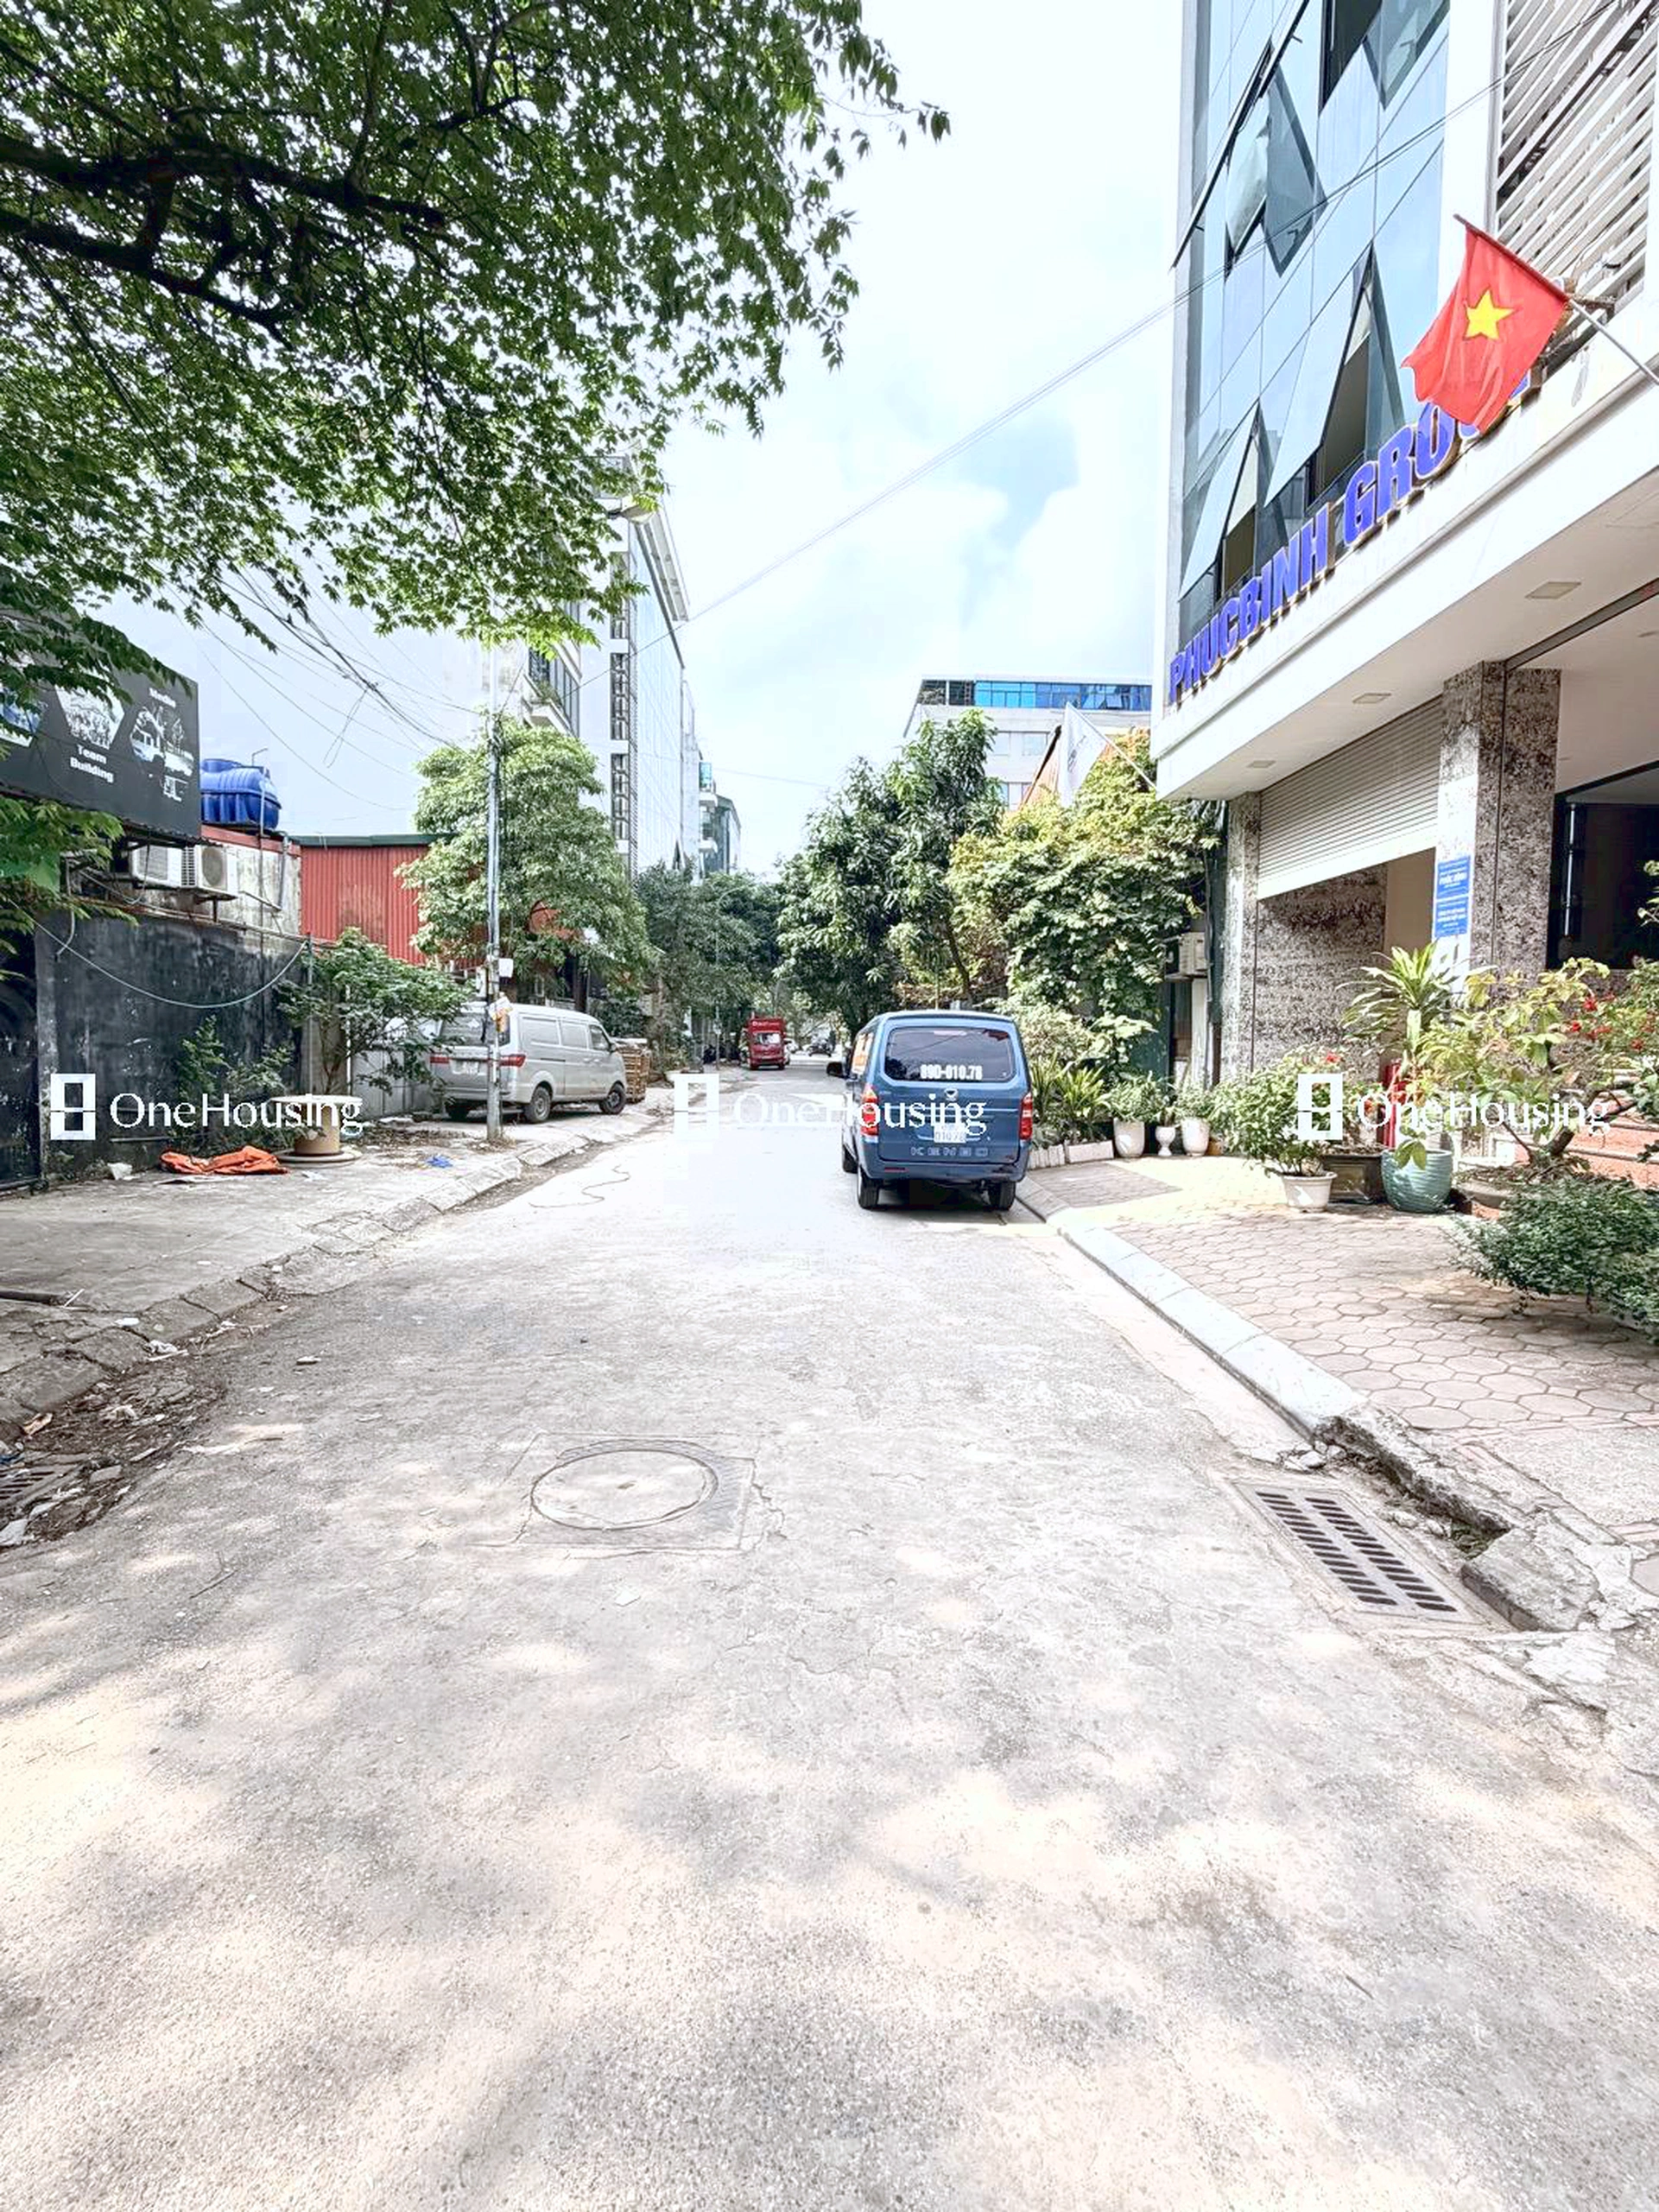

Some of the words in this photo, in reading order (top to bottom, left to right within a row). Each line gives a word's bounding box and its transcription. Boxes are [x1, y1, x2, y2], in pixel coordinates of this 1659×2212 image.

[1169, 501, 1335, 705] PHUCBINH
[77, 744, 107, 764] Team
[70, 757, 114, 783] Building
